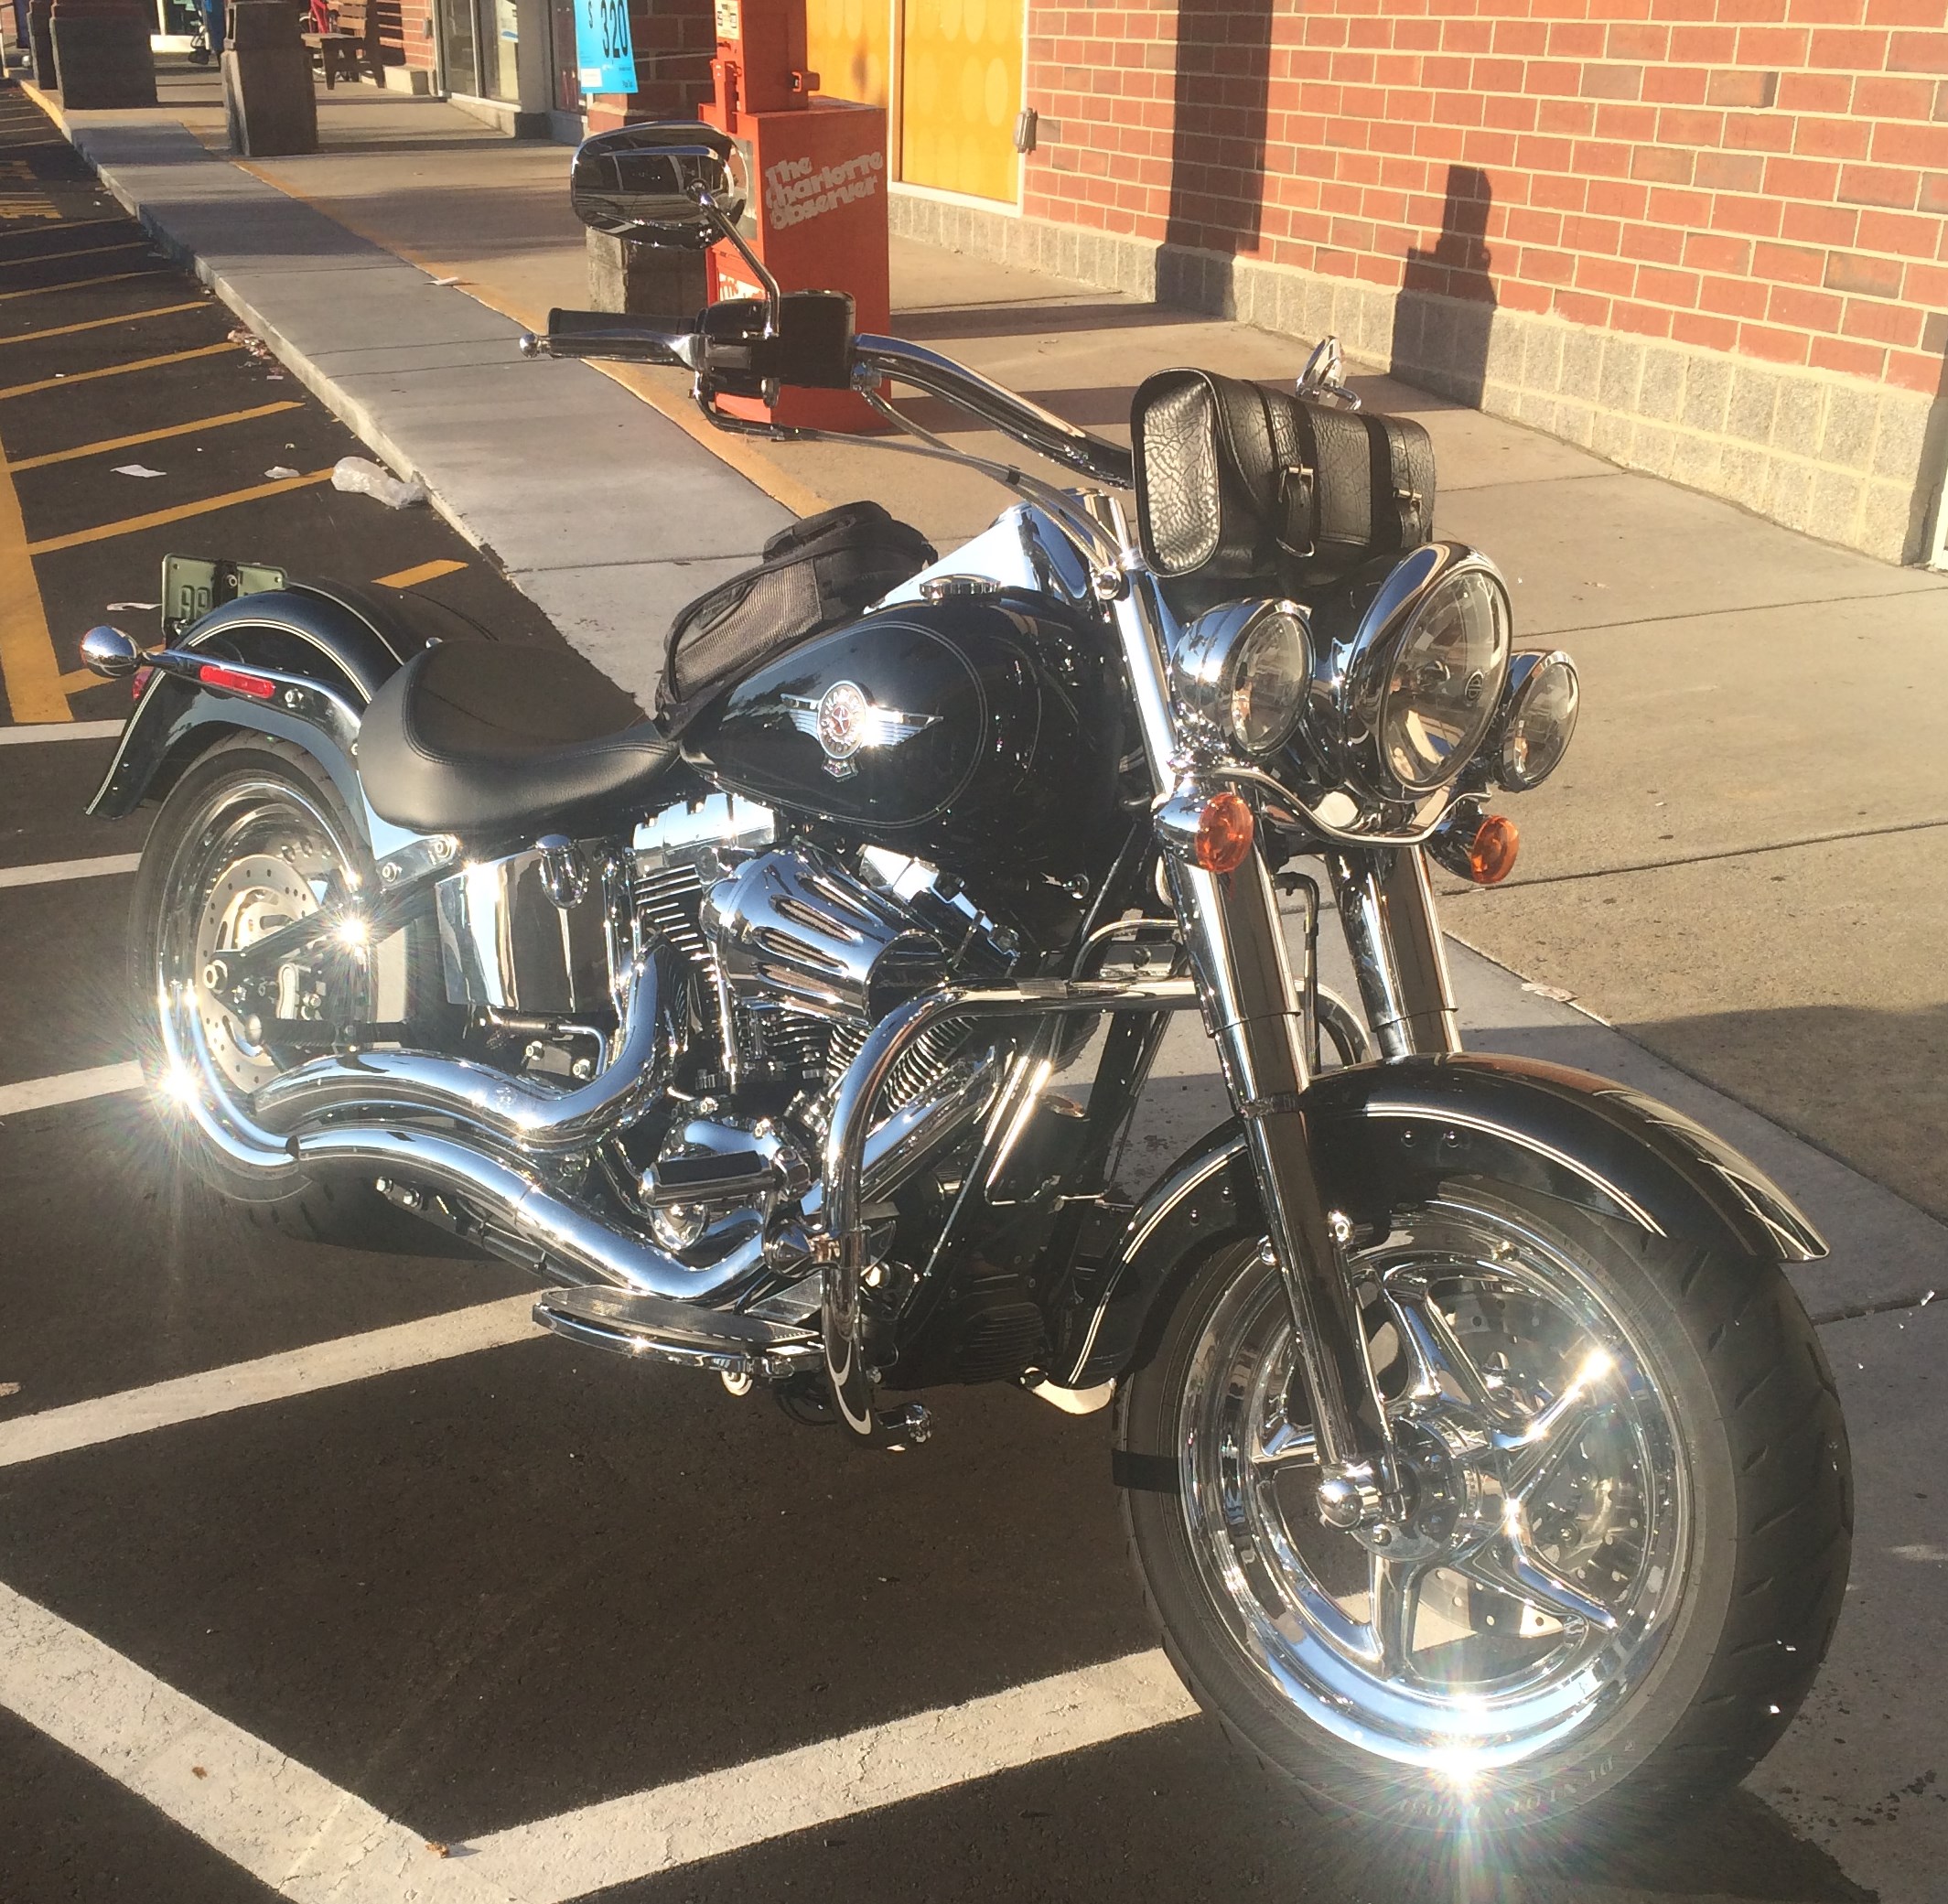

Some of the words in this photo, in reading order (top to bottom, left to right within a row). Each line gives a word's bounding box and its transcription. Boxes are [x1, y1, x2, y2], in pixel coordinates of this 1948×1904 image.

[600, 0, 629, 59] 320
[765, 156, 813, 186] The
[766, 151, 883, 209] Charlotte
[770, 175, 878, 231] Observer
